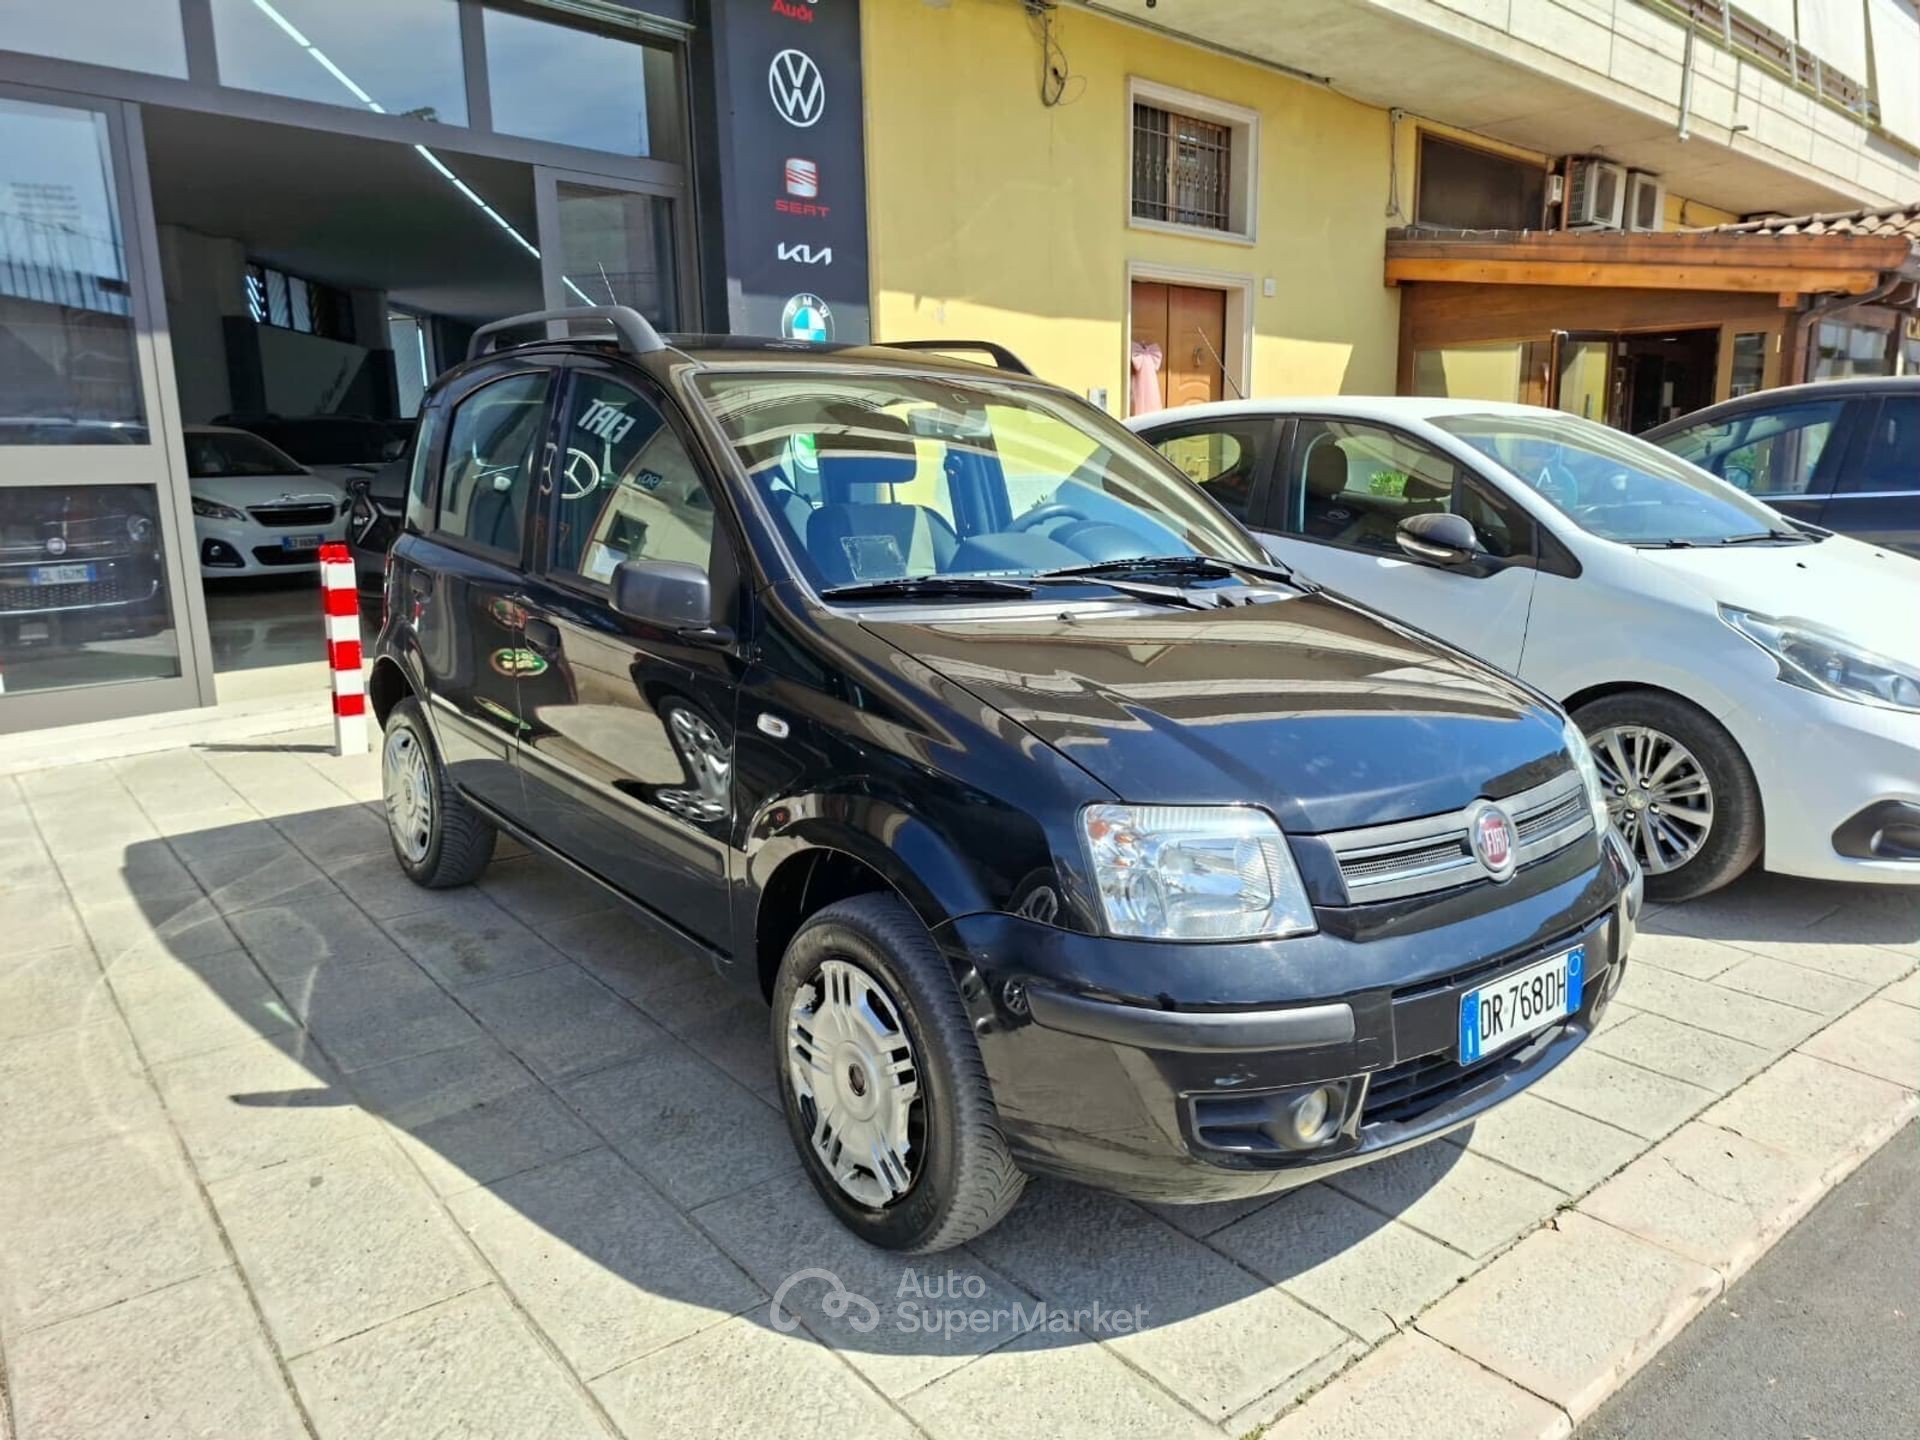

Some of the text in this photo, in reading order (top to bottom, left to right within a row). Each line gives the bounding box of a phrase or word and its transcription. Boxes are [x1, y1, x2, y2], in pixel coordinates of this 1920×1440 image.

[775, 200, 830, 217] SEAT
[1480, 993, 1504, 1041] DR
[1509, 966, 1566, 1029] 768DH
